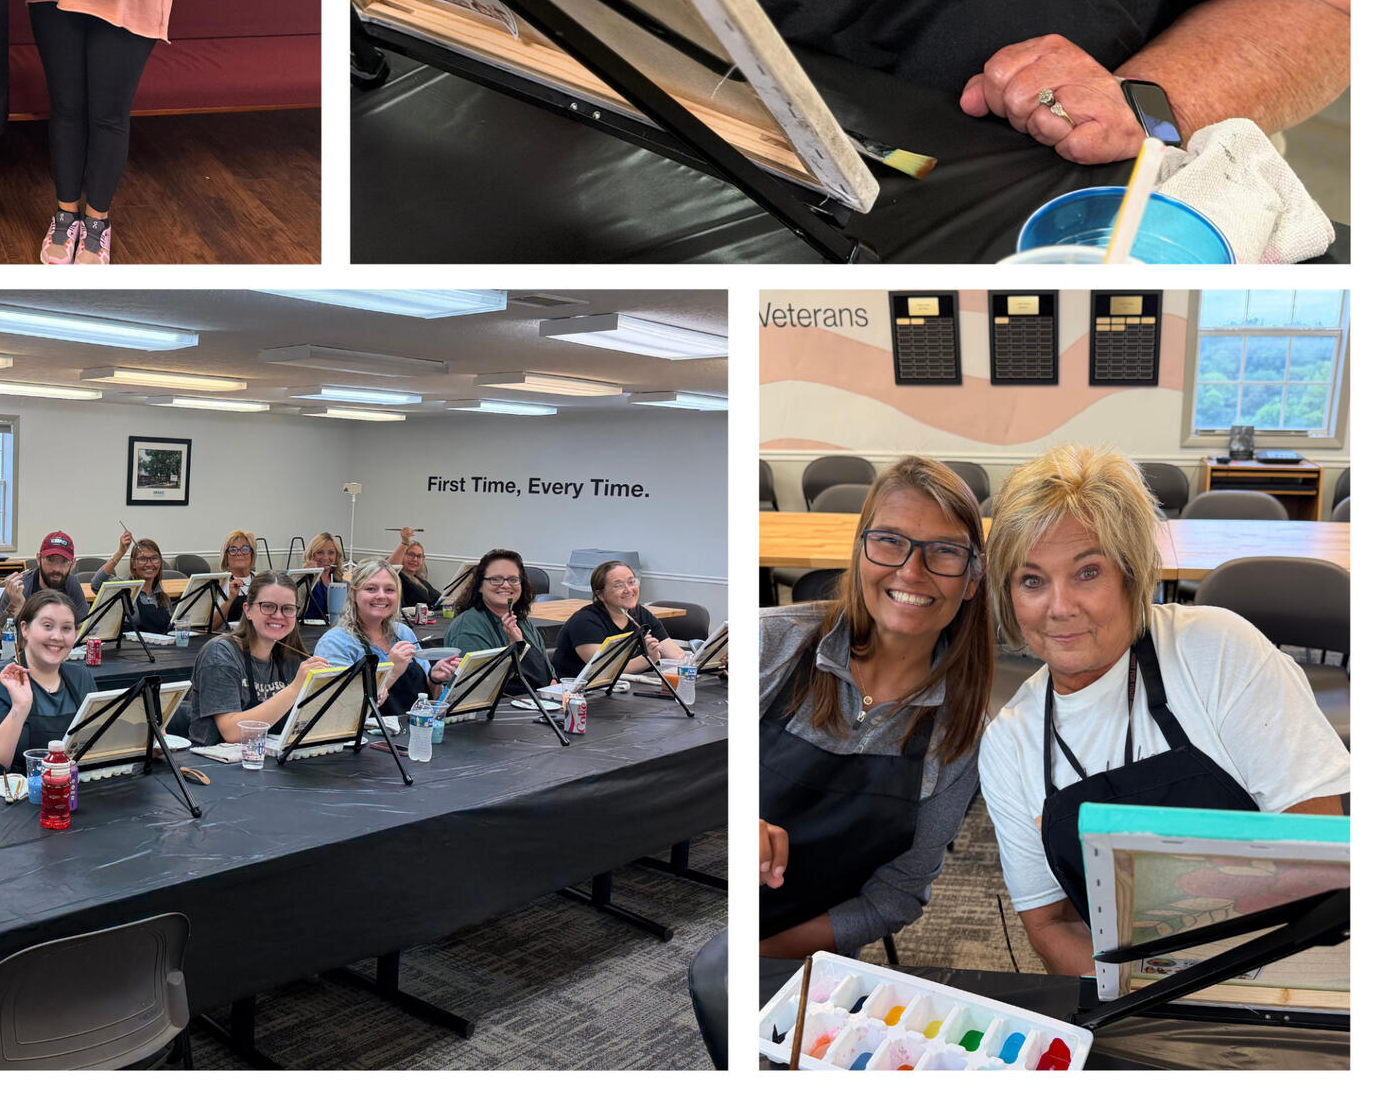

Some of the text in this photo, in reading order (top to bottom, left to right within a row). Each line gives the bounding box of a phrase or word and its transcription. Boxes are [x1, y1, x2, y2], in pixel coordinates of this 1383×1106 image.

[427, 476, 650, 499] First Time, Every Time.
